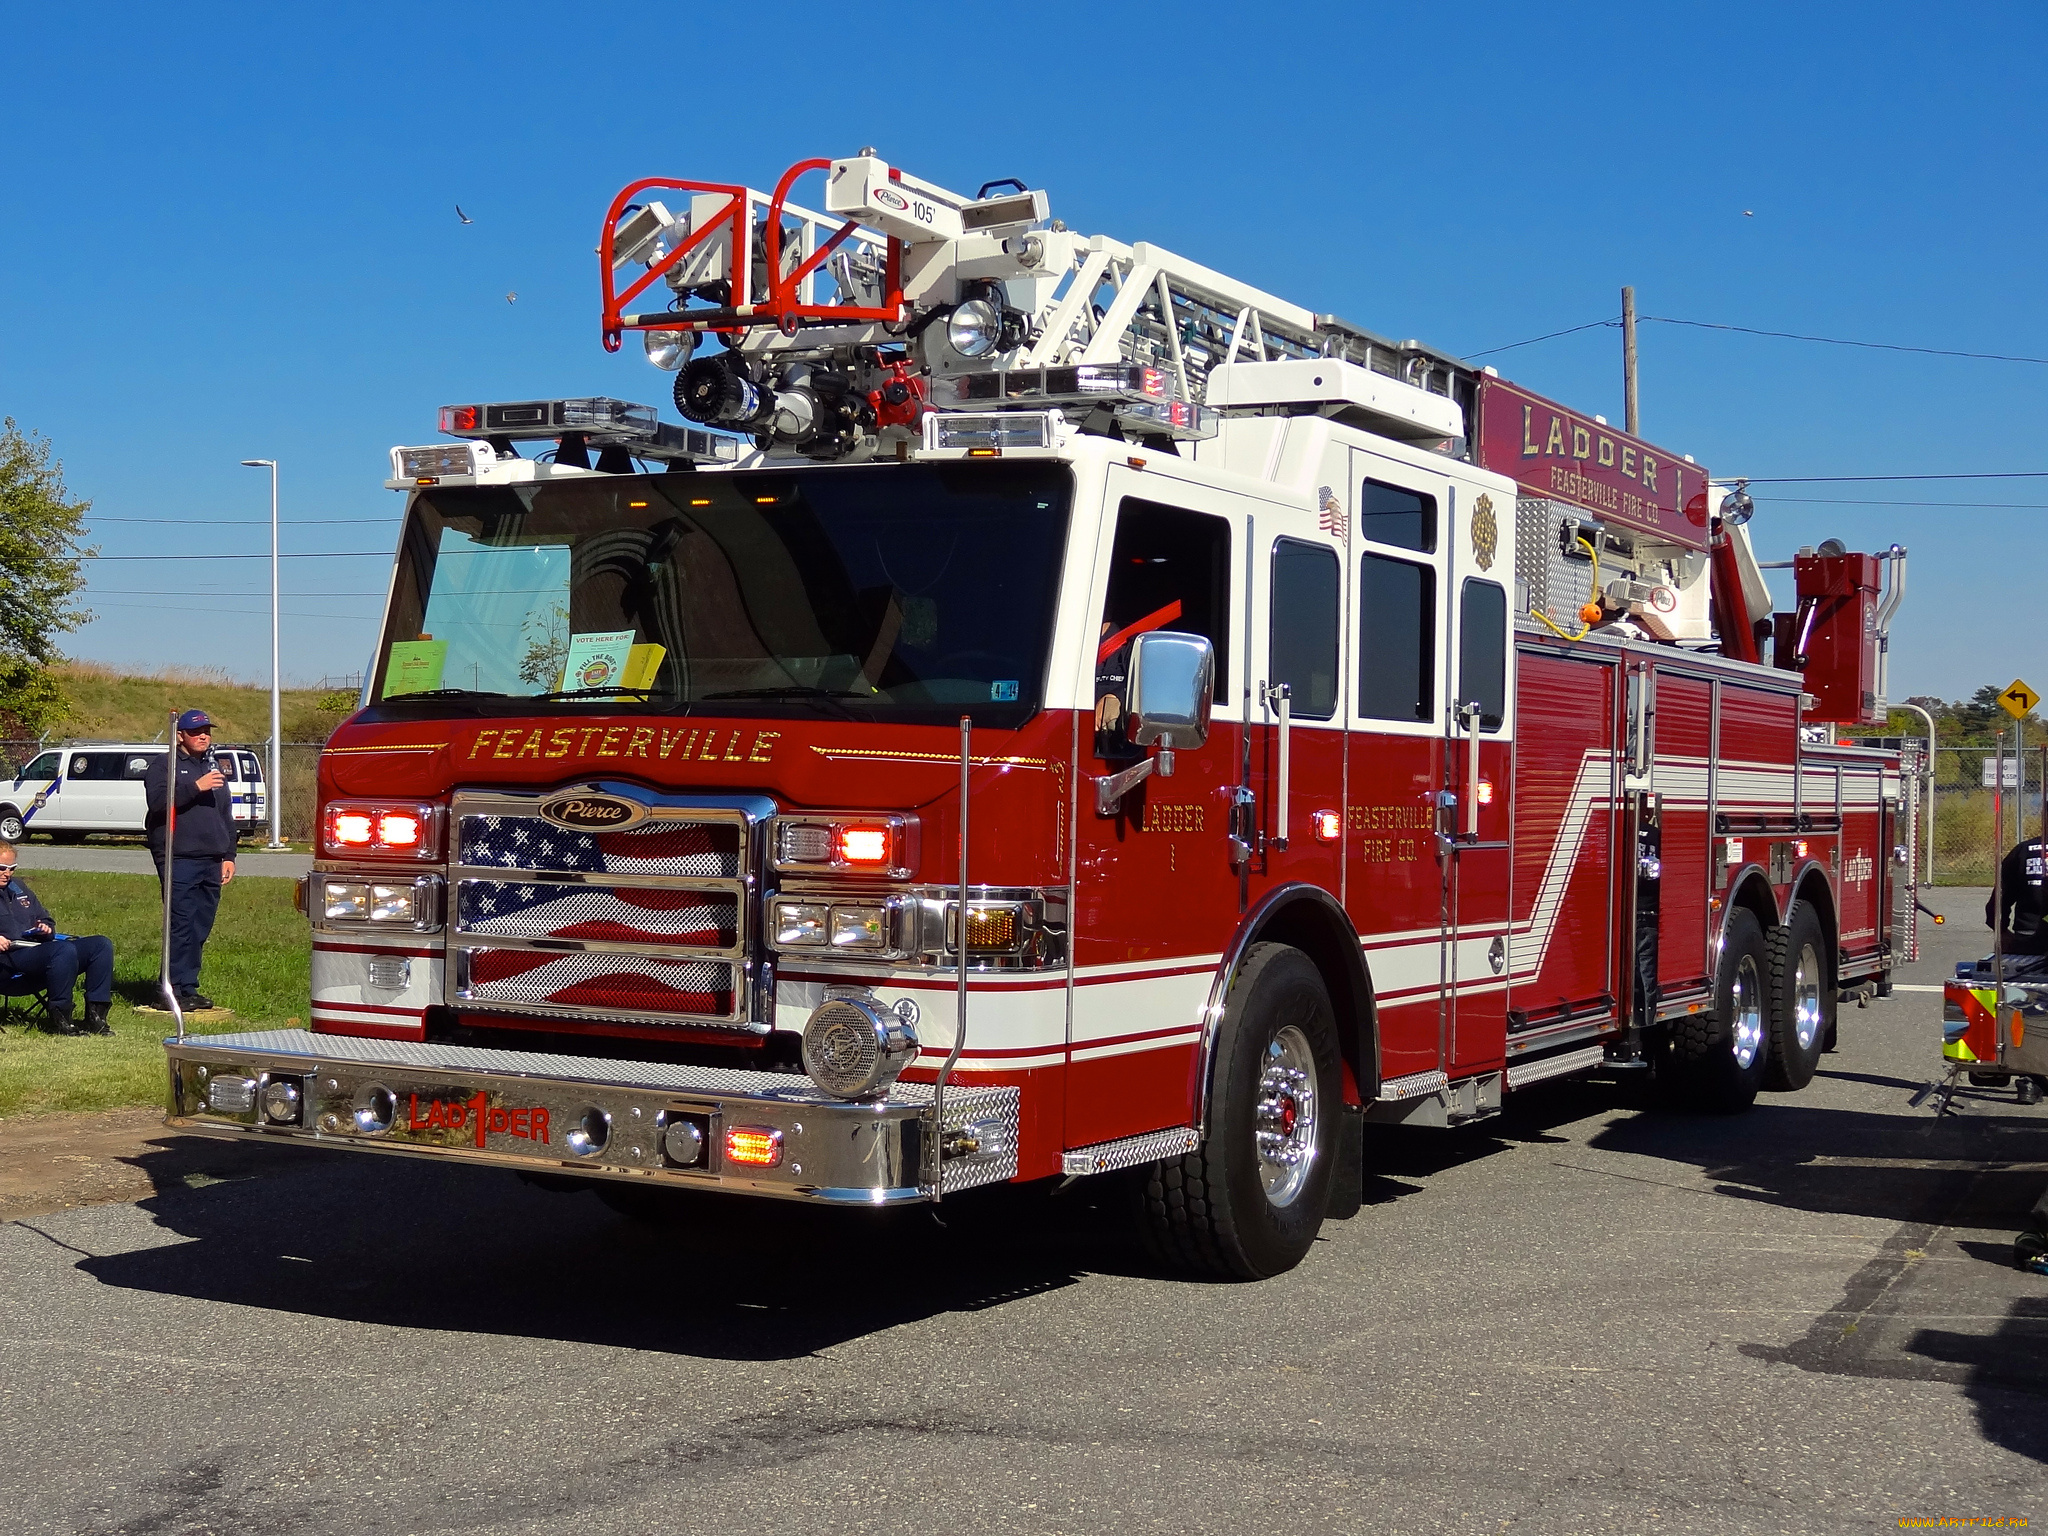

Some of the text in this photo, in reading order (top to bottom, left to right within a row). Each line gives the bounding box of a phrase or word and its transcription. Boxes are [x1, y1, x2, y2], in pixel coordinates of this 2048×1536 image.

[1522, 404, 1658, 494] LADDER
[1550, 466, 1661, 525] FEASTERVILLE FIRE CO.
[579, 659, 592, 671] FILL
[592, 653, 604, 662] THE
[467, 727, 782, 762] FEASTERVILLE
[564, 800, 623, 820] Pierce
[1143, 805, 1204, 832] LADDER
[1347, 806, 1433, 829] FEASTERVILLE
[1364, 839, 1417, 862] FIRE CO.
